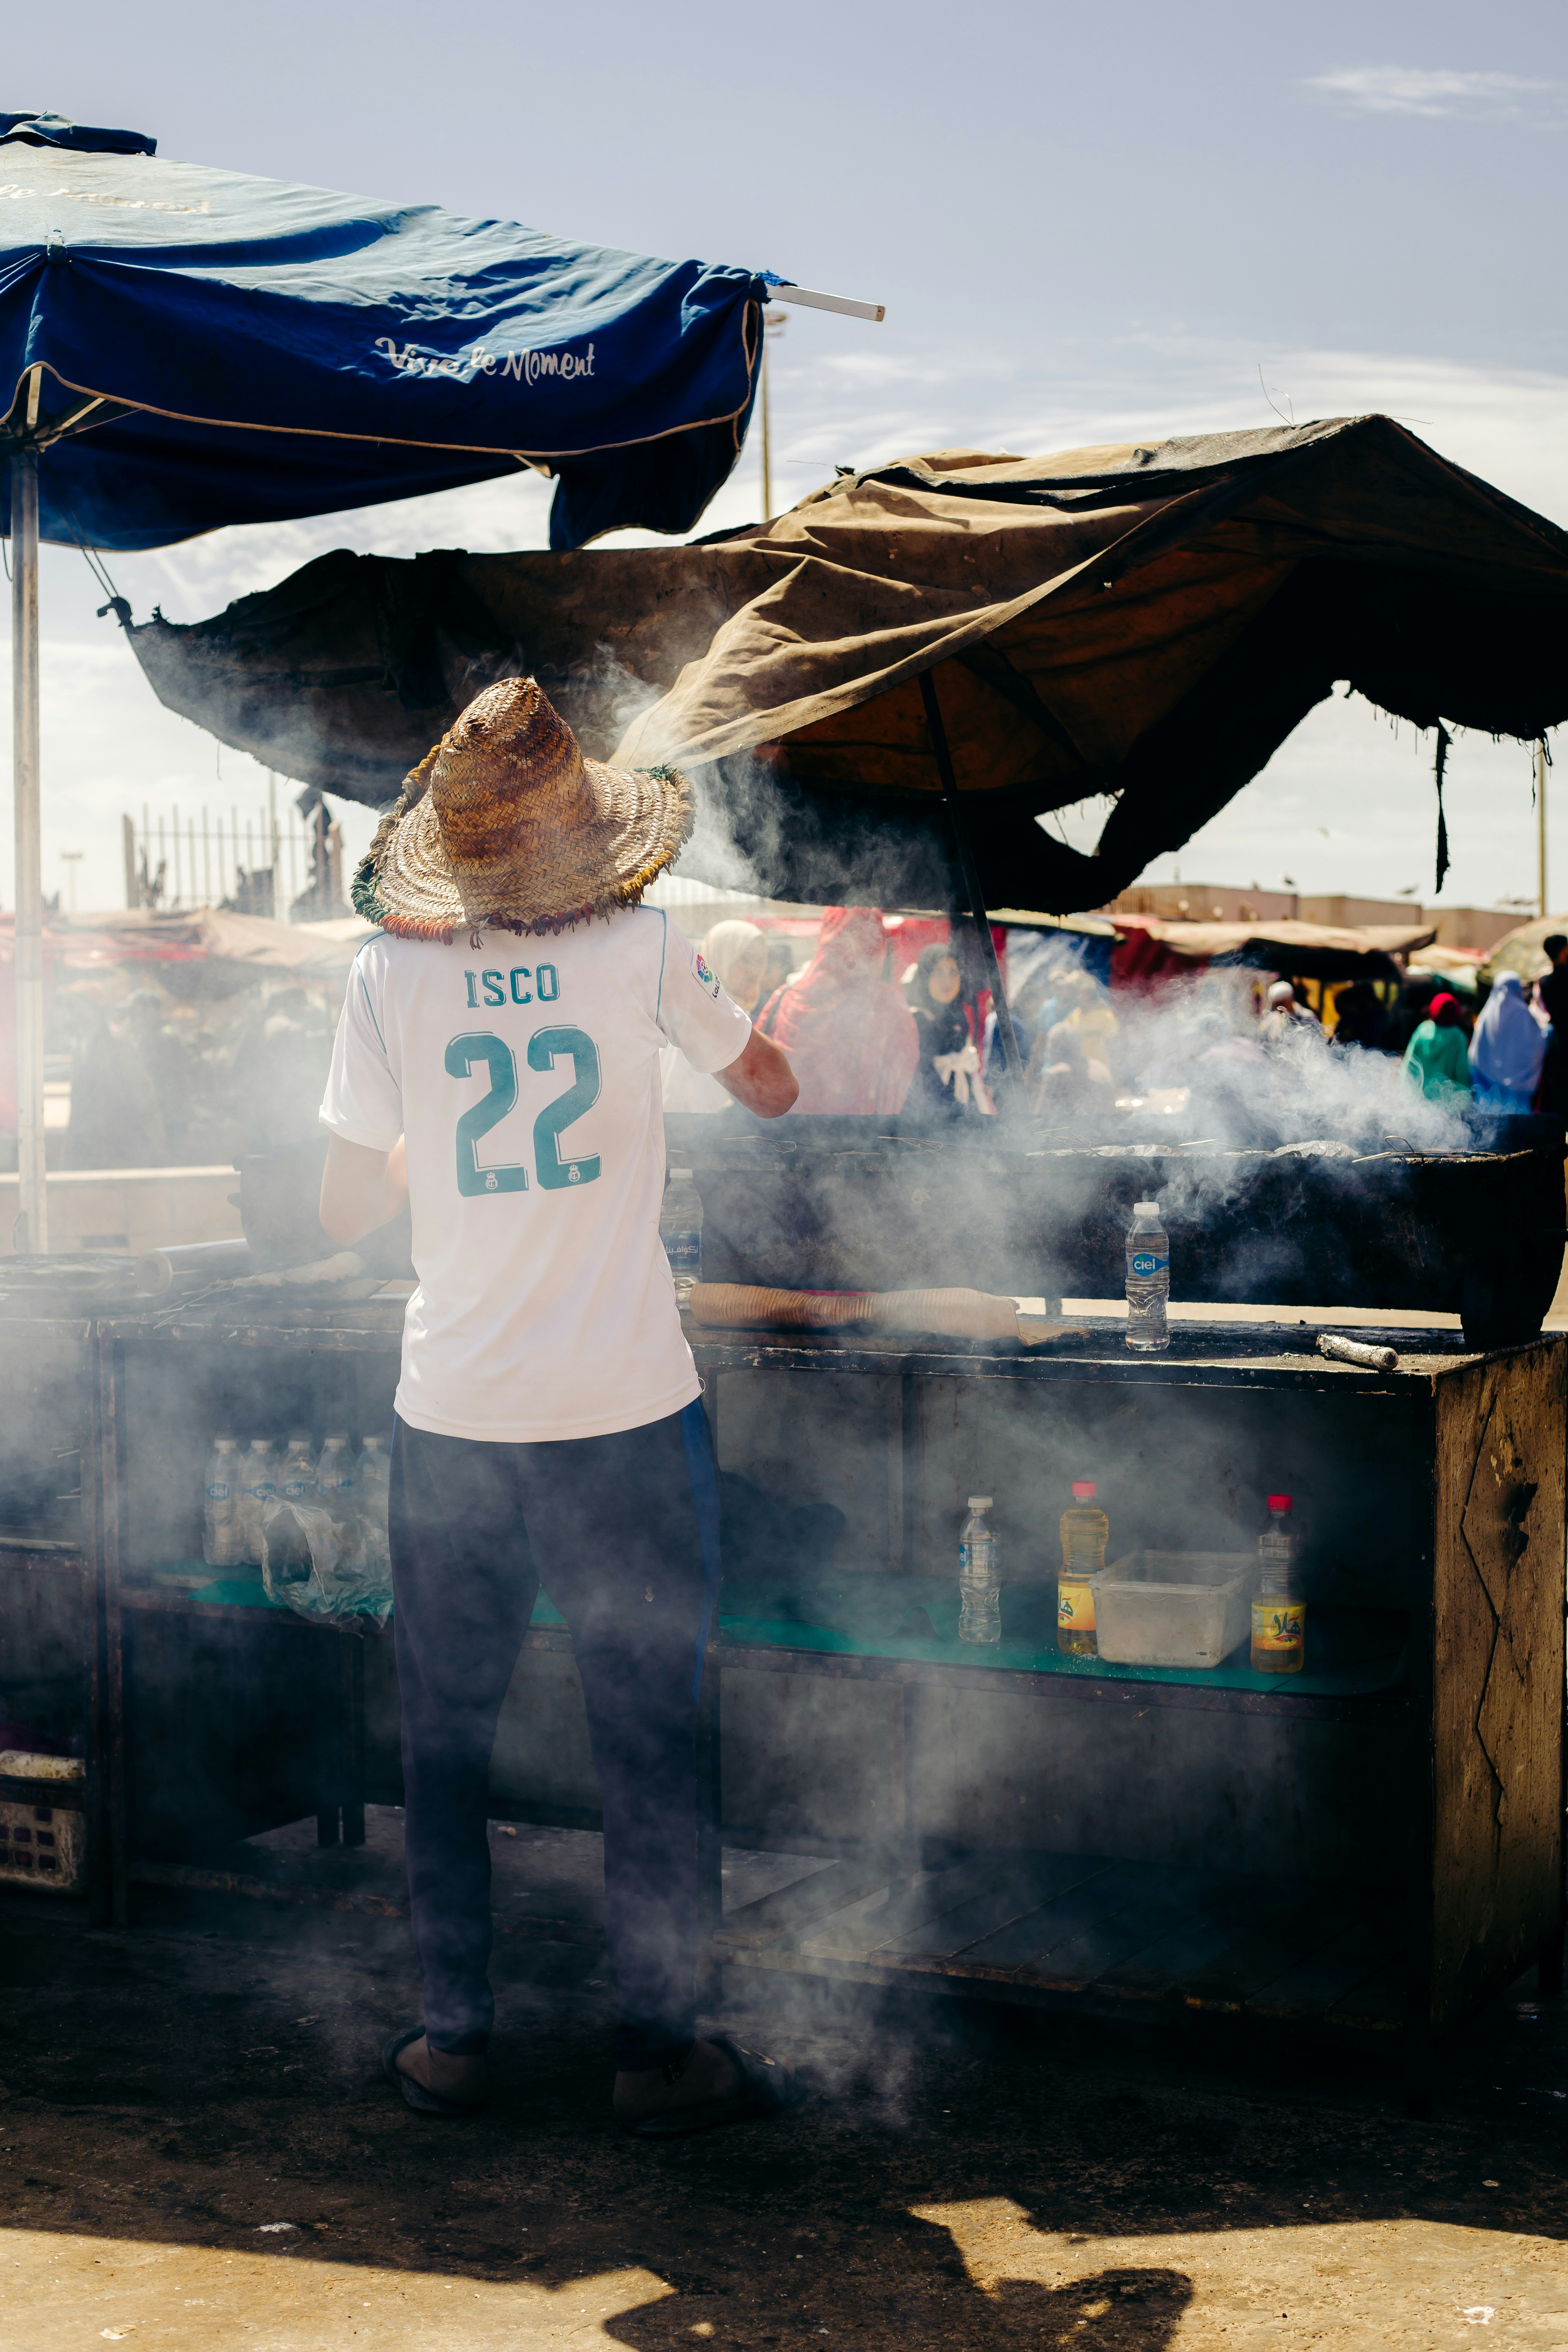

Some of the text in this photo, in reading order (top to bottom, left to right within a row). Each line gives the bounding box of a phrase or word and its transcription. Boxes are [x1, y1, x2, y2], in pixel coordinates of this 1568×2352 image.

[375, 337, 595, 386] Vive le Moment
[464, 962, 560, 1008] ISCO
[444, 1024, 602, 1197] 22
[1134, 1257, 1155, 1270] ciel
[210, 1486, 228, 1497] ciel
